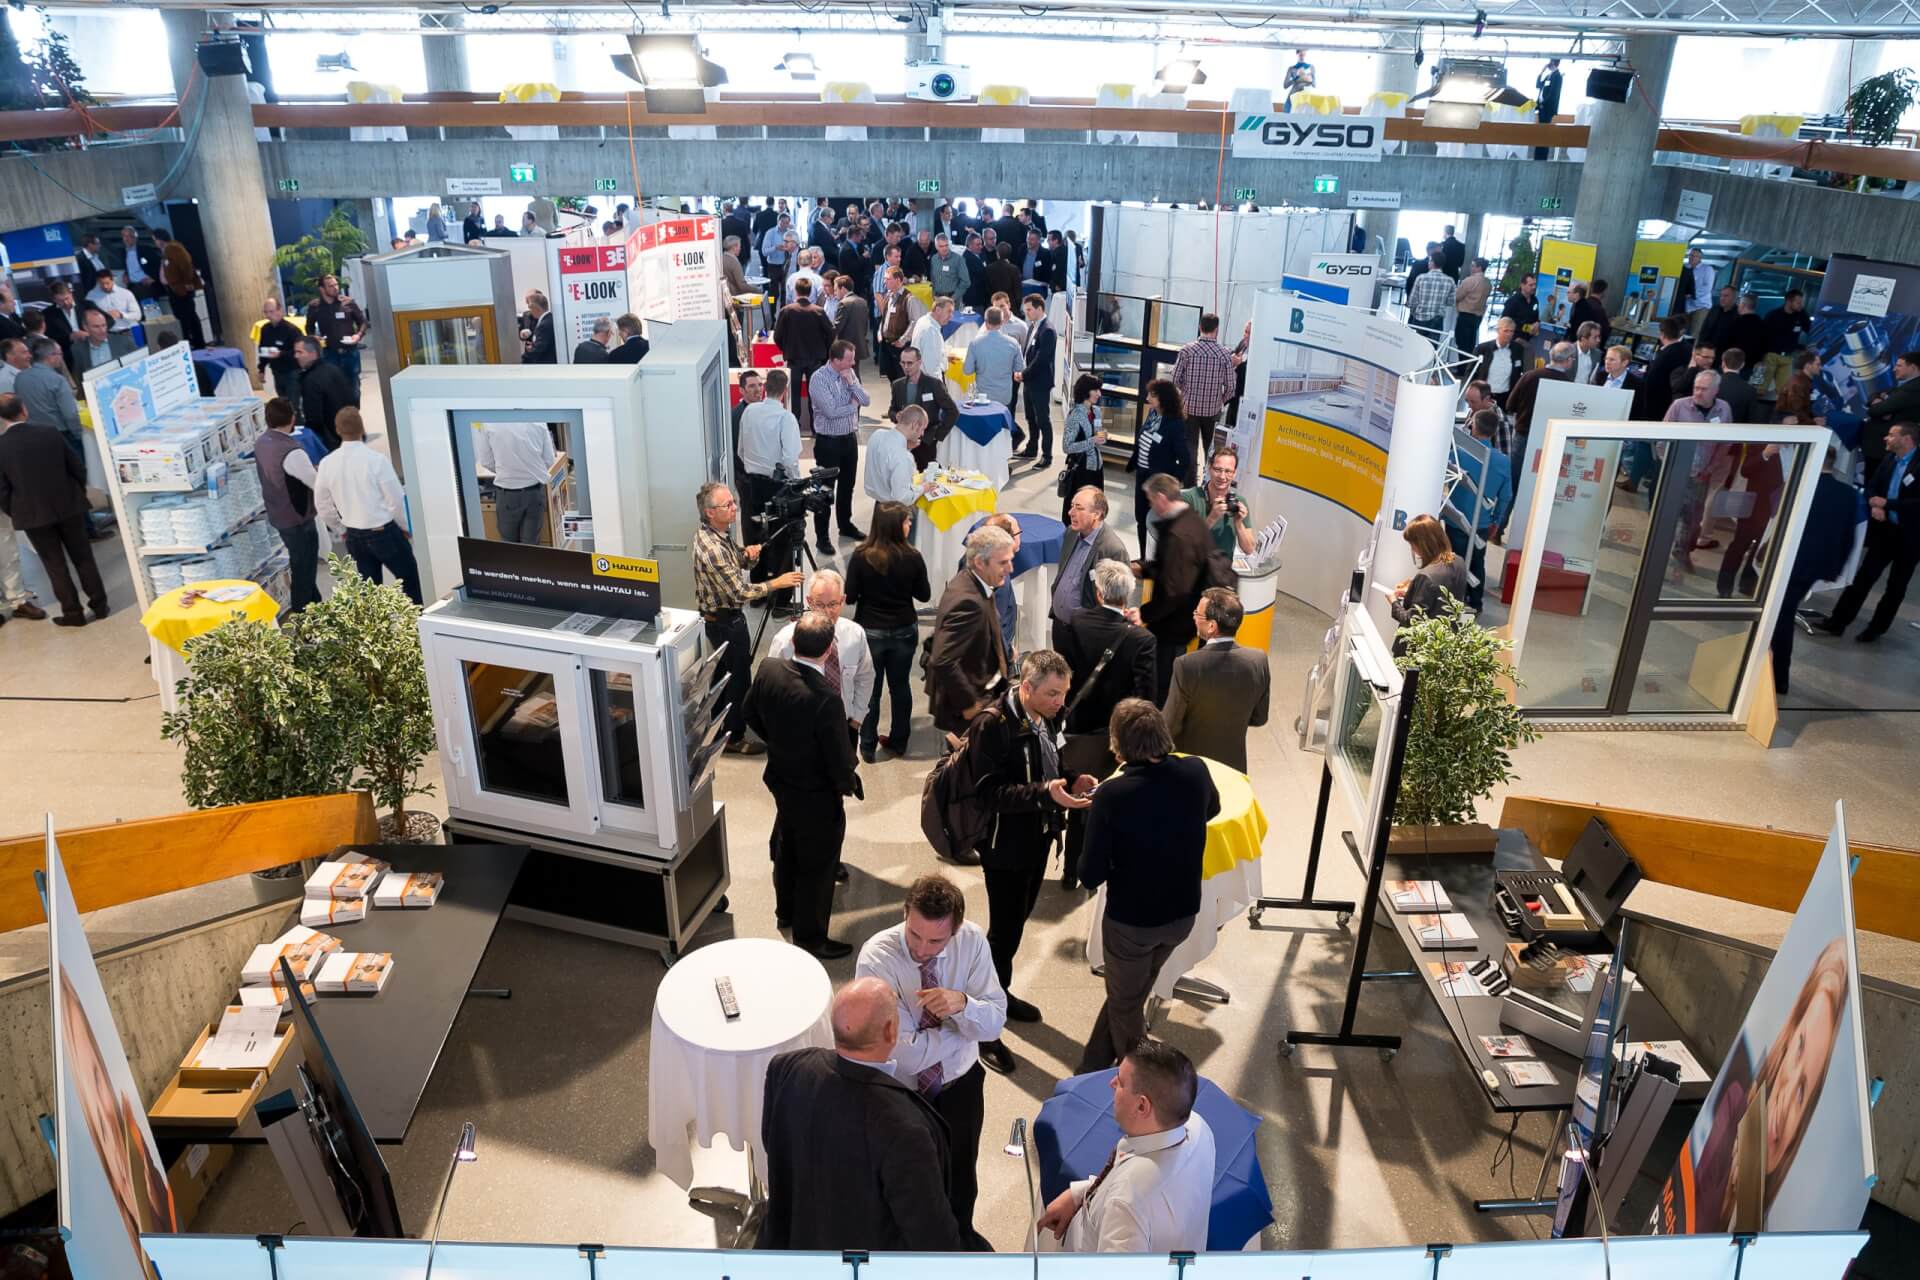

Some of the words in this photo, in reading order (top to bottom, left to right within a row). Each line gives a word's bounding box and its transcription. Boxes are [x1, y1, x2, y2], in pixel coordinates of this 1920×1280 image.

[1262, 121, 1374, 149] GYSO
[1326, 264, 1372, 276] GYSO
[612, 563, 653, 573] HAUTAU
[468, 567, 482, 576] Sie
[484, 570, 520, 581] werden's
[521, 575, 555, 586] merken,
[556, 580, 579, 589] wenn
[593, 583, 632, 595] HAUTAU
[633, 590, 649, 598] ist.
